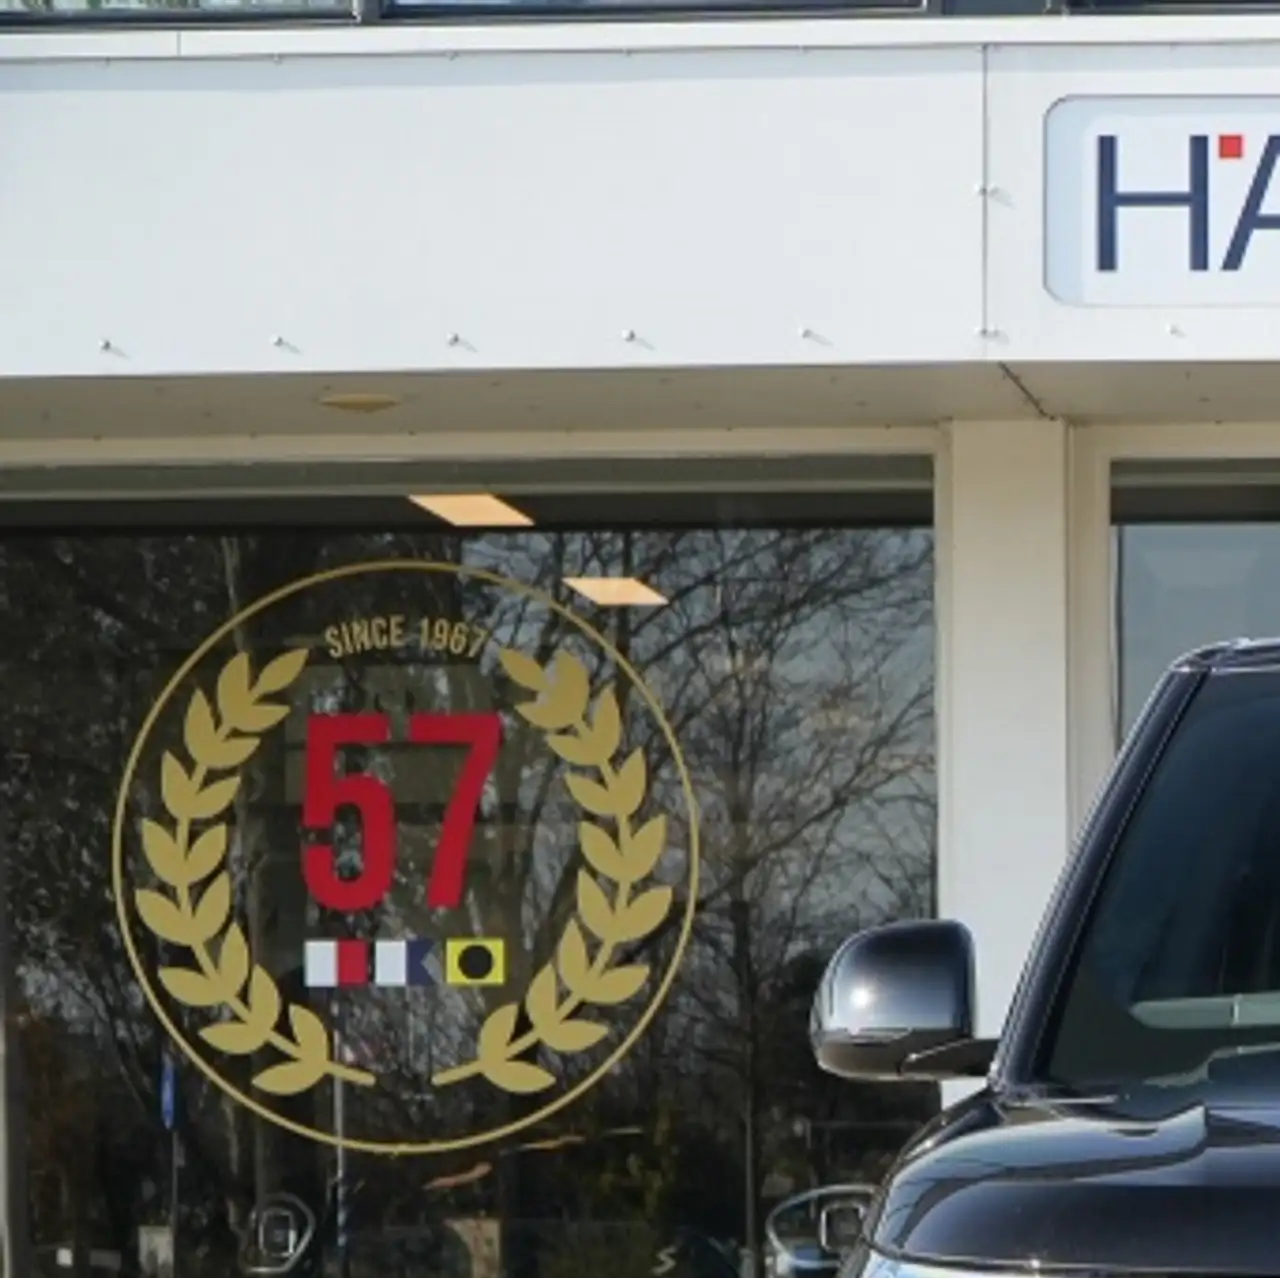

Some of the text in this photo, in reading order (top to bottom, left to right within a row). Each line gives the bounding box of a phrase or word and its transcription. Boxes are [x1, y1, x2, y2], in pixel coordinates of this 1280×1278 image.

[325, 613, 490, 660] SINCE 1967
[302, 712, 505, 914] 57
